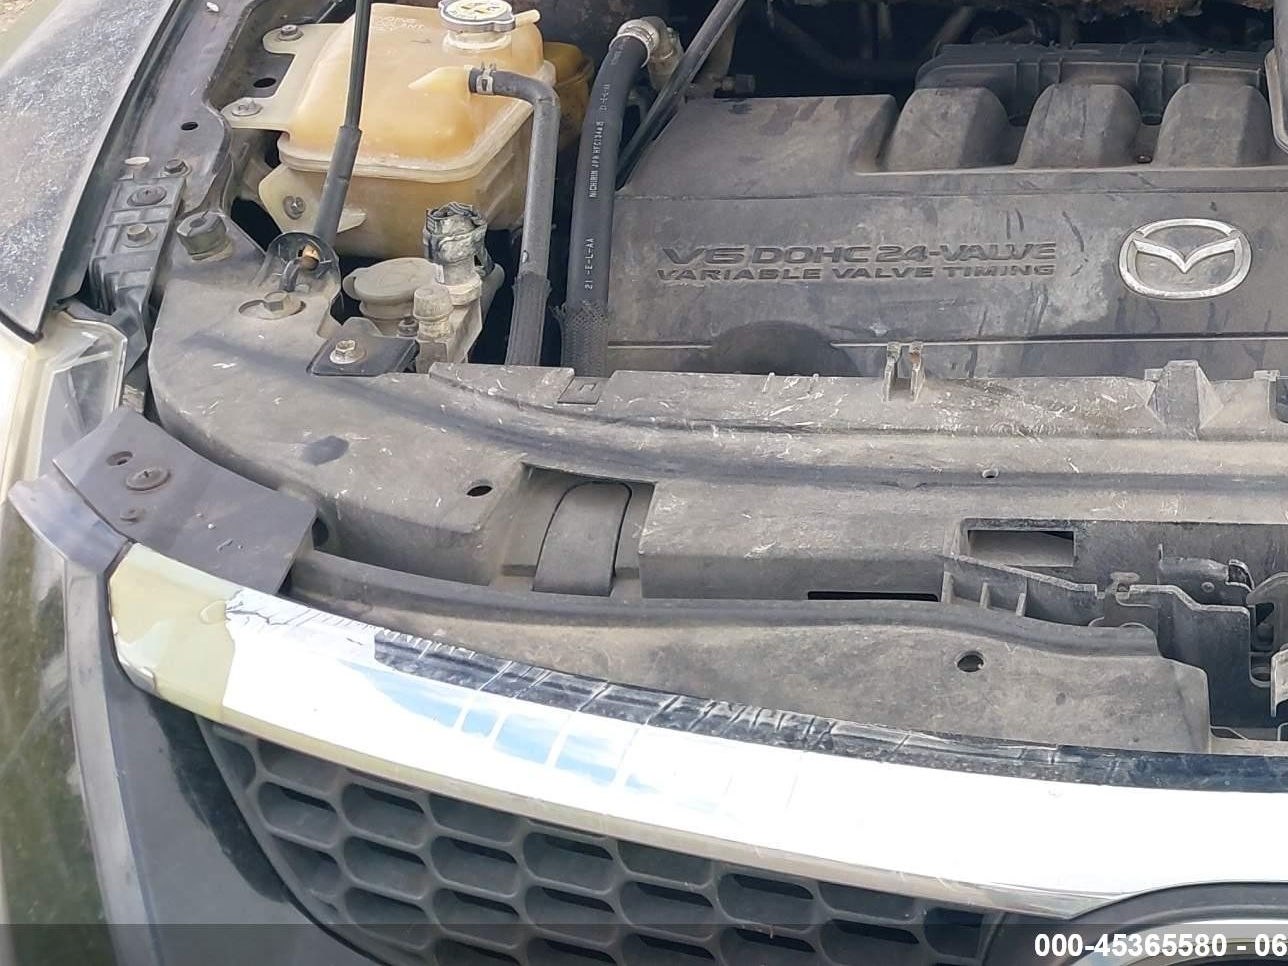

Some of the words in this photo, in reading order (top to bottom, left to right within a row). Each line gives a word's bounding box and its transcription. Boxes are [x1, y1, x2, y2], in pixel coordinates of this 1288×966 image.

[662, 247, 745, 265] V6
[751, 247, 870, 264] DOHC
[876, 242, 1056, 263] 24-VALVE
[656, 269, 821, 281] VARIABLE
[831, 267, 934, 279] VALVE
[942, 265, 1055, 277] TIMING
